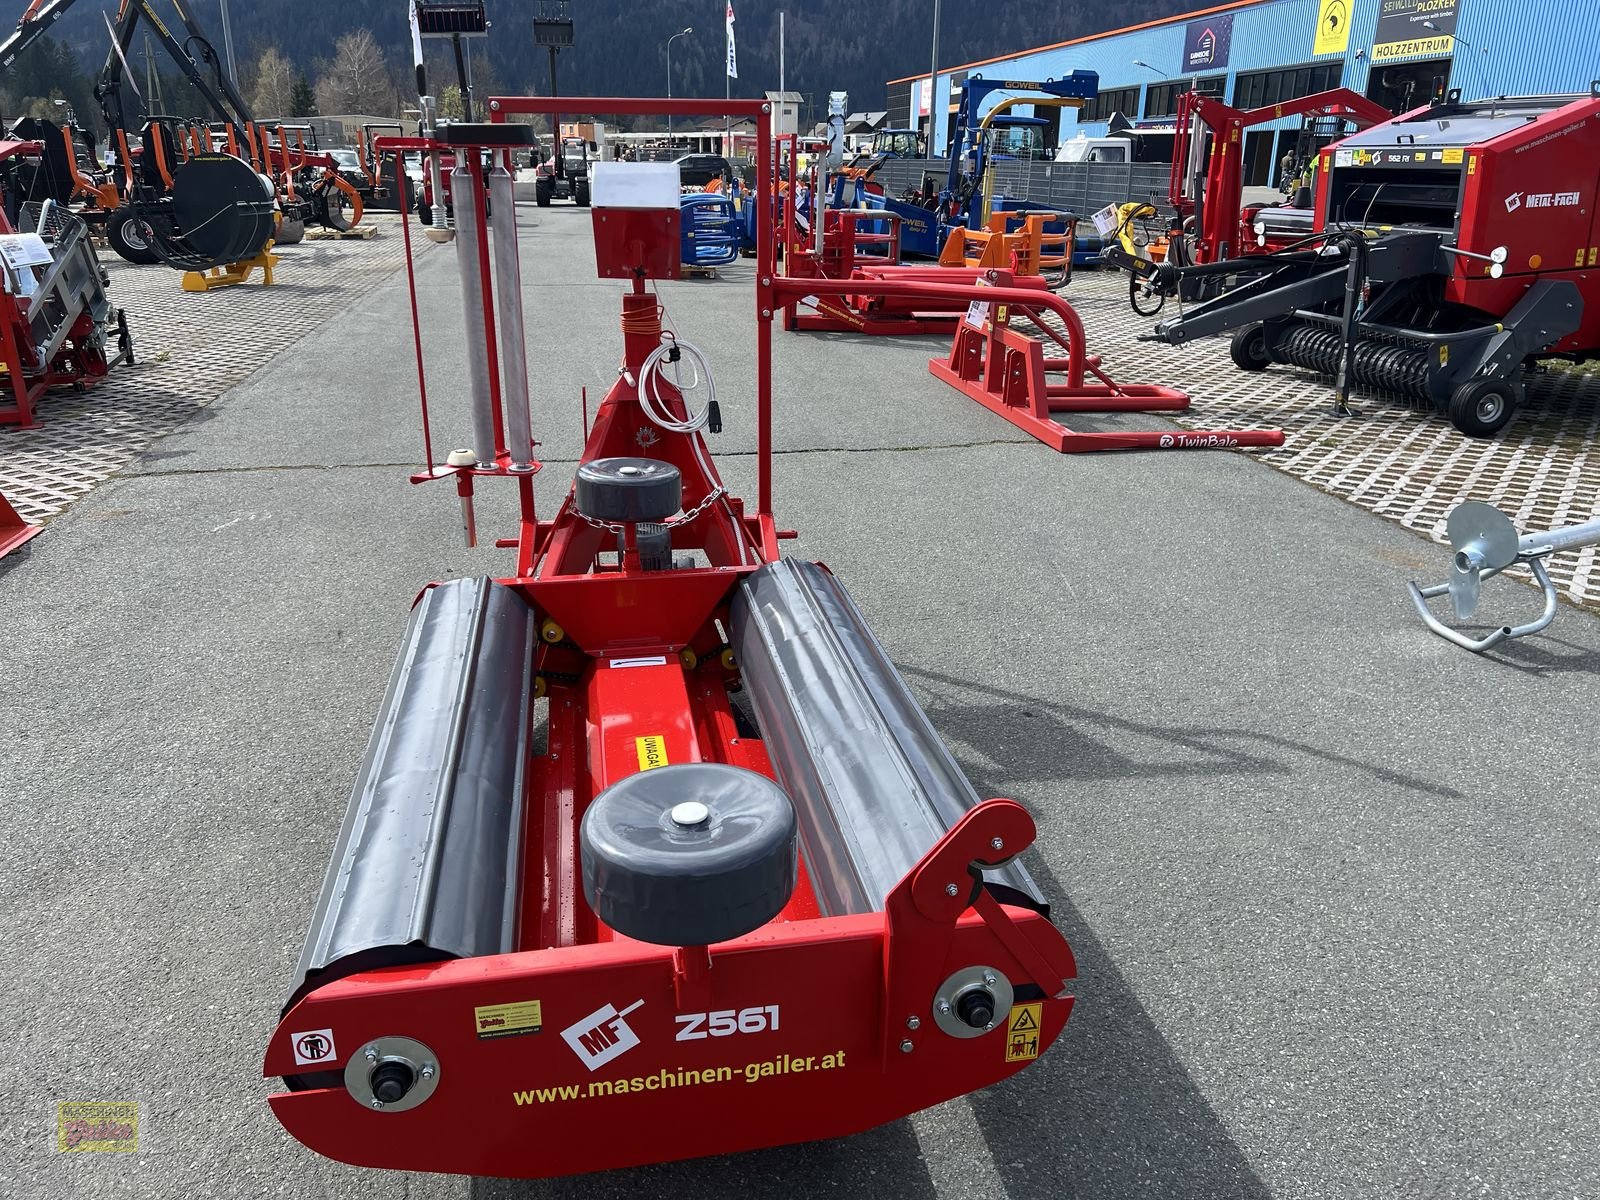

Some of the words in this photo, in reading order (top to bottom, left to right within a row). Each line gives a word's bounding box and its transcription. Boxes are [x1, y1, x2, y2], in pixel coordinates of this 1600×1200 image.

[1376, 38, 1449, 57] HOLZZENTRUM
[1515, 120, 1586, 154] www.maschinen-gailer.at
[1178, 435, 1238, 447] TwinBale
[644, 737, 660, 768] UWAGA!
[577, 1022, 622, 1057] MF
[675, 1005, 779, 1041] Z561
[513, 1050, 846, 1106] www.maschinen-gailer.at
